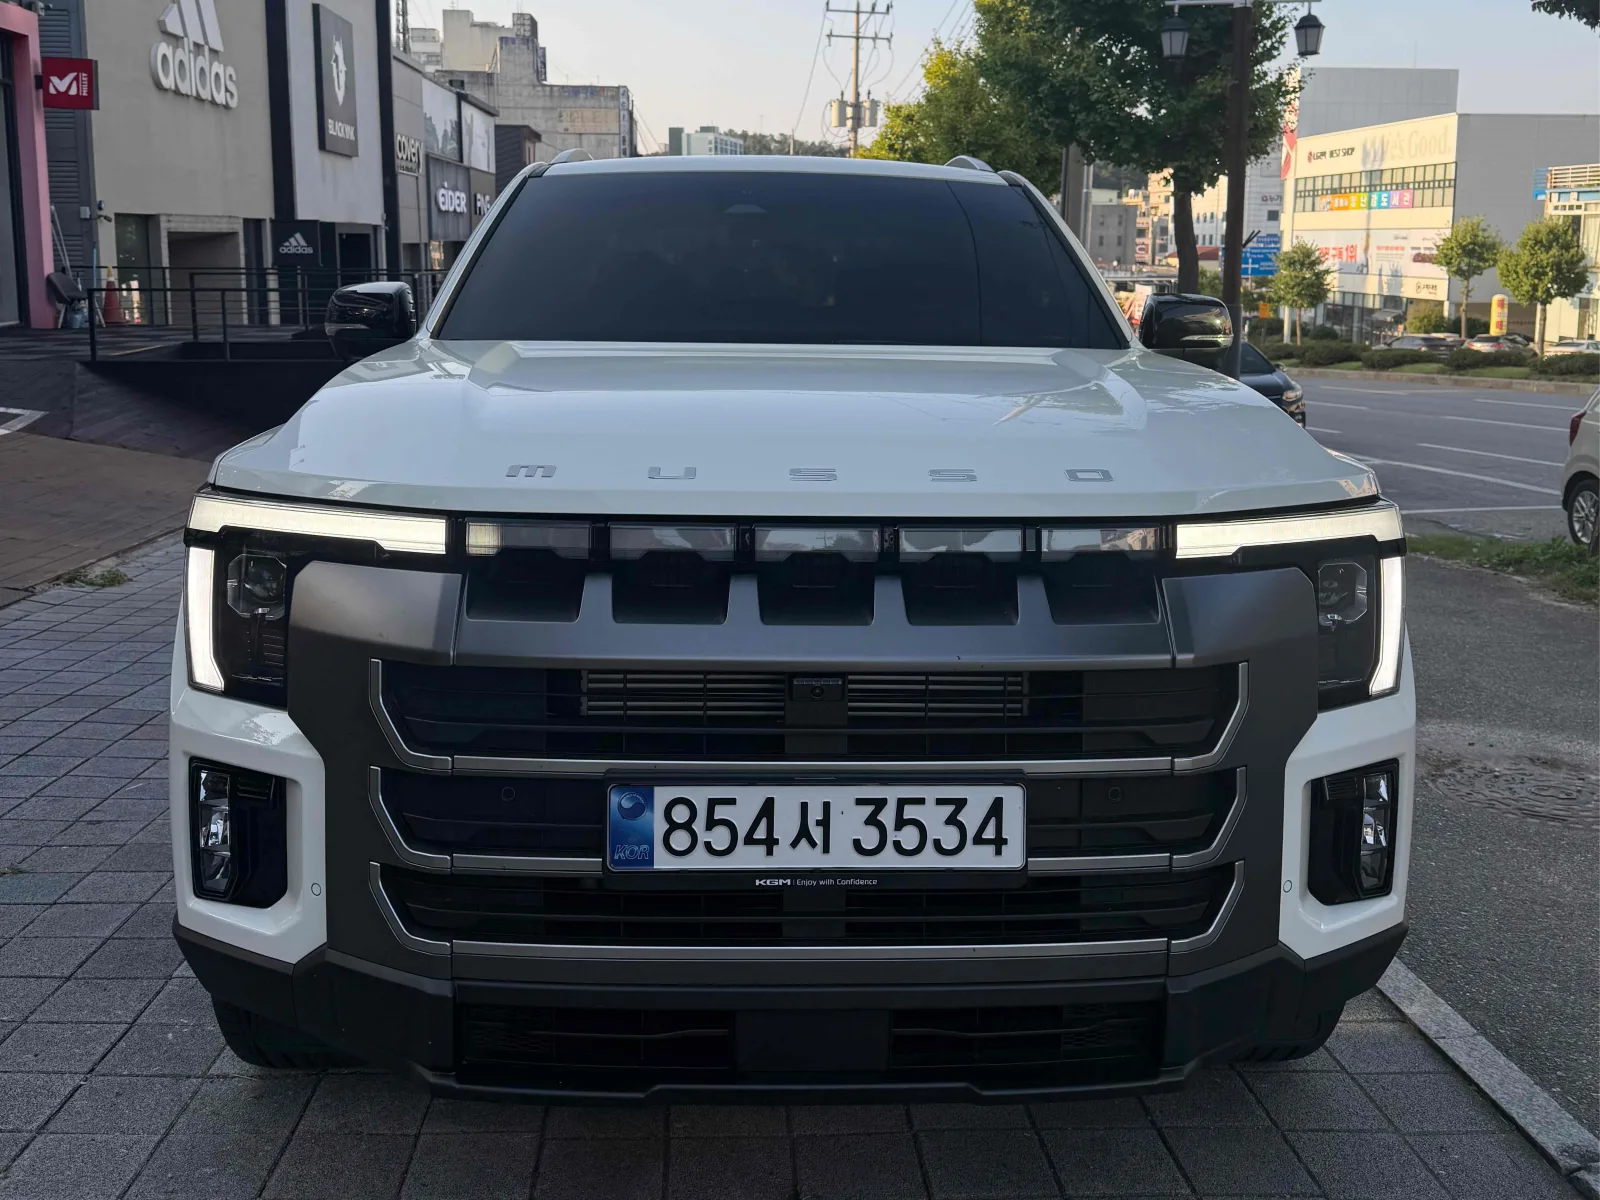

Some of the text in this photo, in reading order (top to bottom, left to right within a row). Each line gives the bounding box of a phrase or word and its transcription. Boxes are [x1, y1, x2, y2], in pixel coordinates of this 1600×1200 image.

[151, 42, 238, 109] adidas
[81, 73, 89, 96] MILLET
[1342, 147, 1355, 157] SHOP
[279, 245, 313, 254] adidas
[662, 795, 1009, 858] 854서 3534
[614, 844, 650, 860] KOR
[796, 878, 817, 887] Enjoy
[819, 878, 834, 886] with
[837, 878, 878, 886] Confidence
